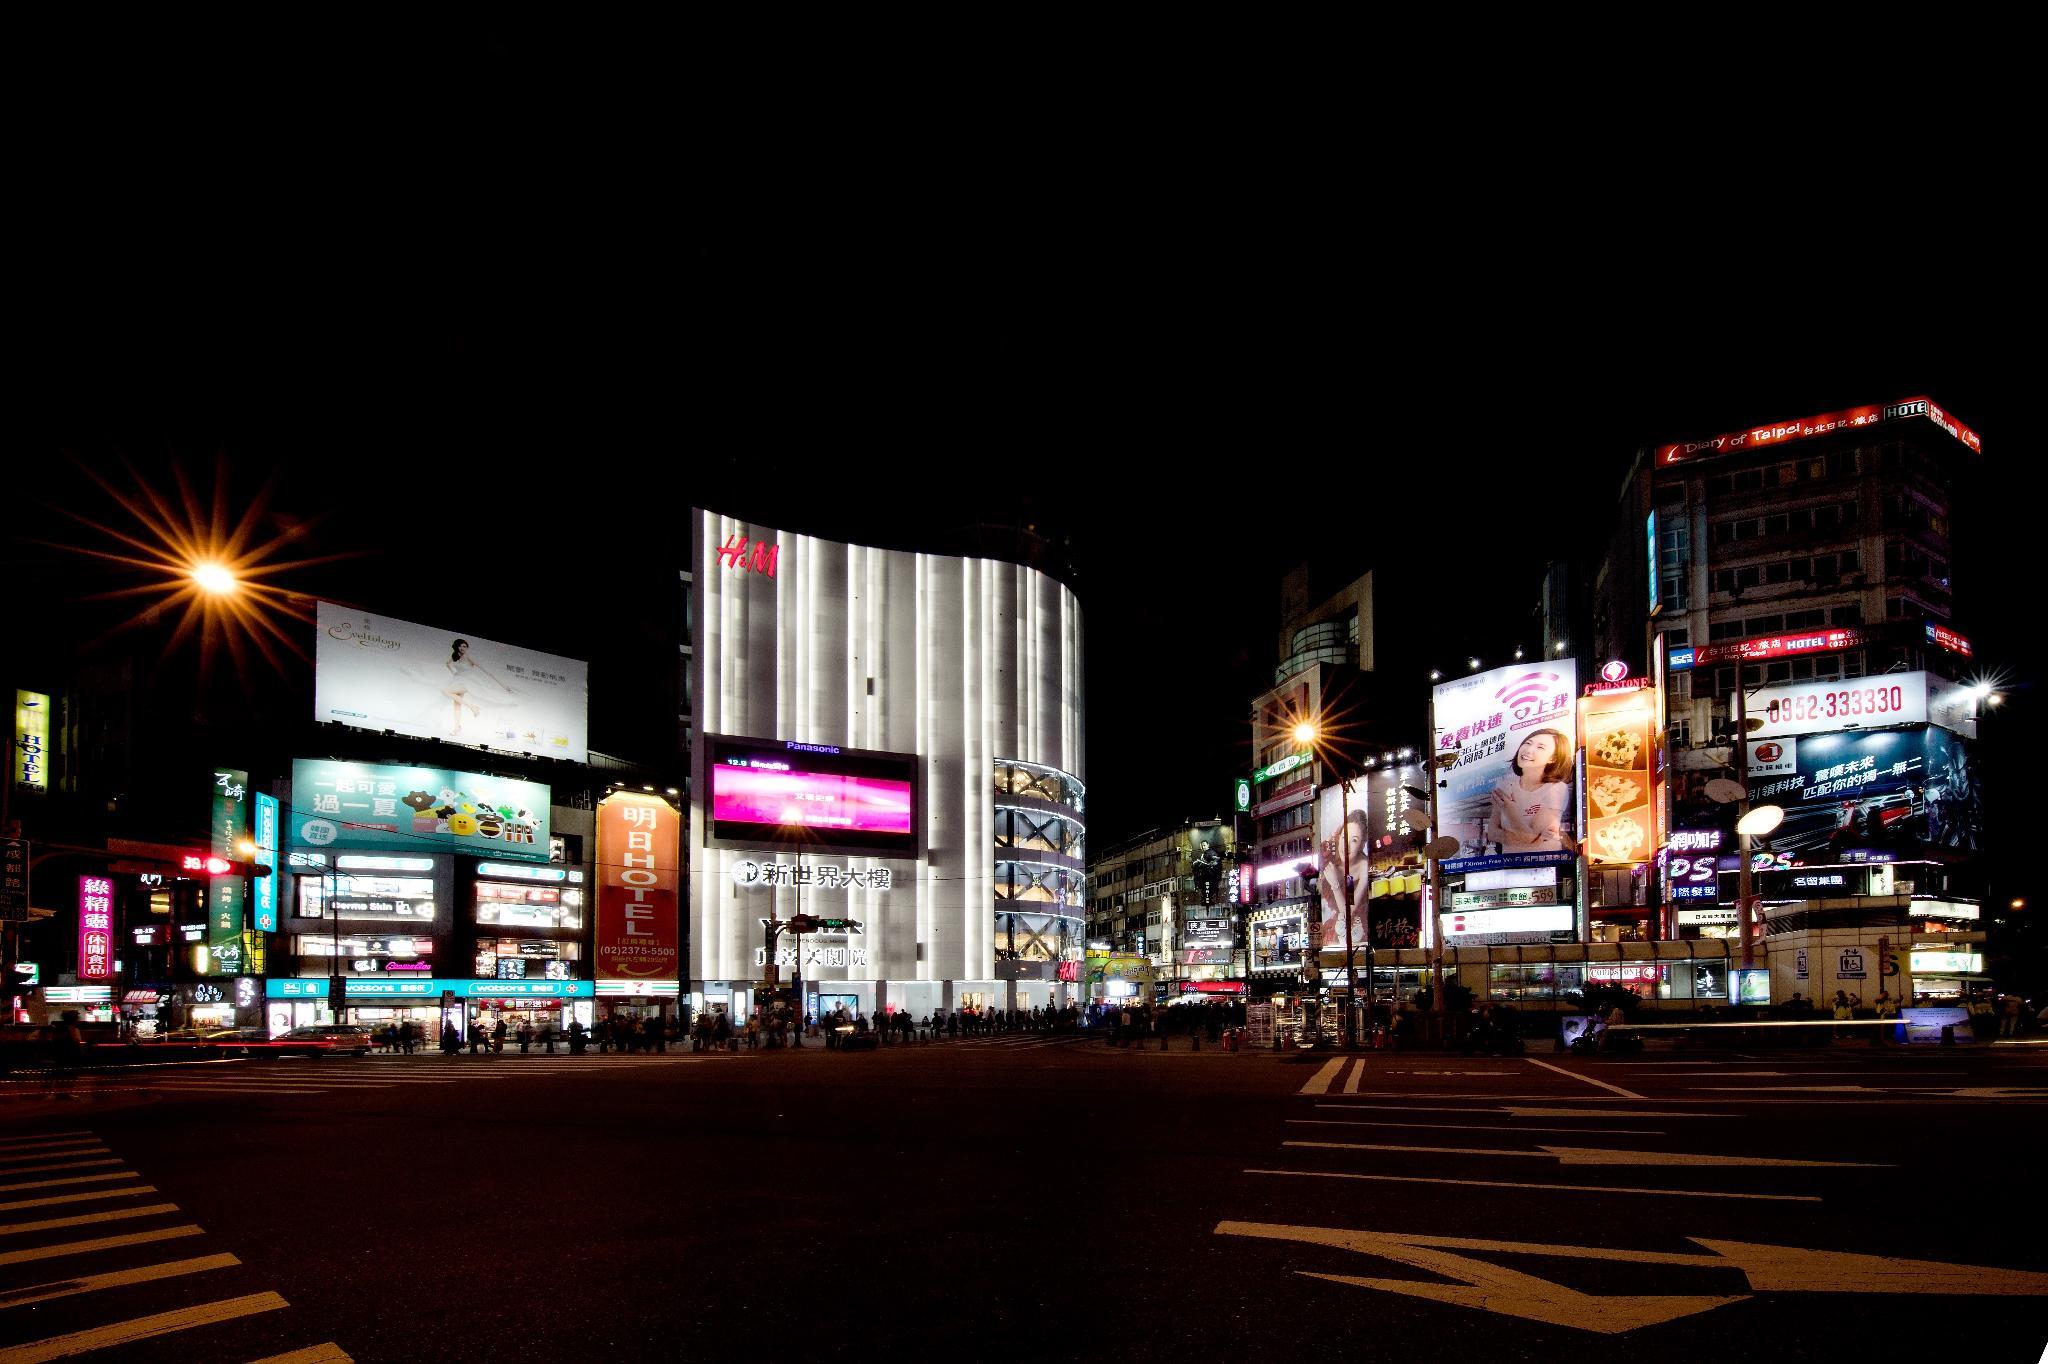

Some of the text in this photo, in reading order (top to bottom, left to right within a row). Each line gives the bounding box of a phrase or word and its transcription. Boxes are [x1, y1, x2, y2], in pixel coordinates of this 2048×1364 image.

[1887, 402, 1927, 417] HOTEL
[1684, 423, 1800, 454] Diary of Taipei
[716, 535, 779, 579] H&M
[1787, 638, 1824, 649] HOTEL
[1585, 677, 1649, 695] COLD STONE
[1440, 712, 1503, 749] 免費快速
[22, 734, 41, 782] HOTEL
[787, 741, 840, 754] Panasonic
[315, 779, 398, 796] 一起可愛
[1803, 757, 1922, 800] 匹配你的獨一無二
[313, 793, 398, 817] 過一夏
[762, 863, 890, 889] 新世界大樓
[84, 878, 110, 929] 綠精靈
[370, 902, 393, 911] Skin
[1531, 890, 1554, 903] 599
[87, 935, 105, 975] 休閒食品
[600, 946, 675, 956] (02)2375-5500
[1060, 960, 1078, 981] H&M
[477, 984, 527, 993] watsons
